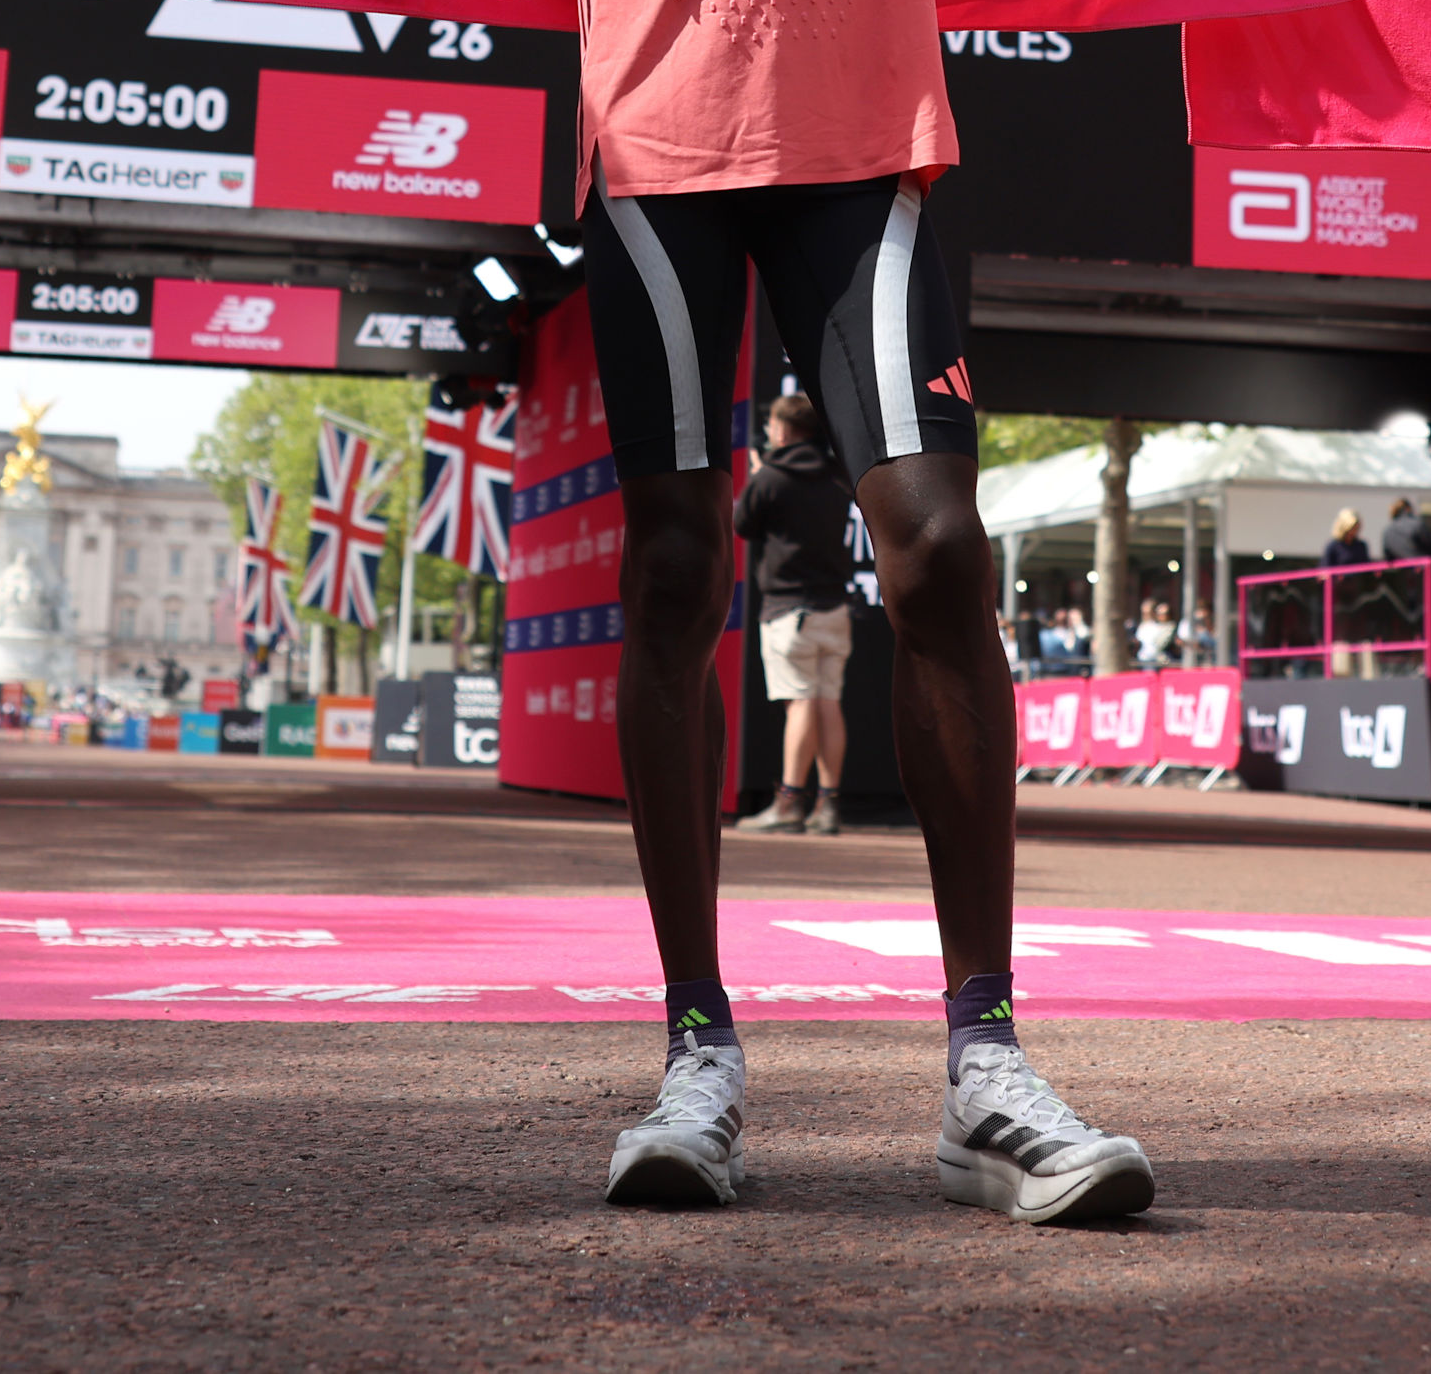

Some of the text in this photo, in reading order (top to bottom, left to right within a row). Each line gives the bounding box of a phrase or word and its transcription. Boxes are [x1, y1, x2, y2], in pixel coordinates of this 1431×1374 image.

[429, 23, 492, 60] 26
[946, 31, 1072, 63] VICES
[35, 75, 227, 132] 2:05:00
[332, 169, 480, 199] new balance
[1317, 175, 1387, 197] ABBOTT
[1316, 195, 1384, 212] WORLD
[1316, 211, 1418, 232] MARATHON
[1316, 228, 1388, 248] MAJORS
[32, 283, 139, 315] 2:05:00
[223, 335, 283, 351] balance
[453, 721, 501, 765] tc
